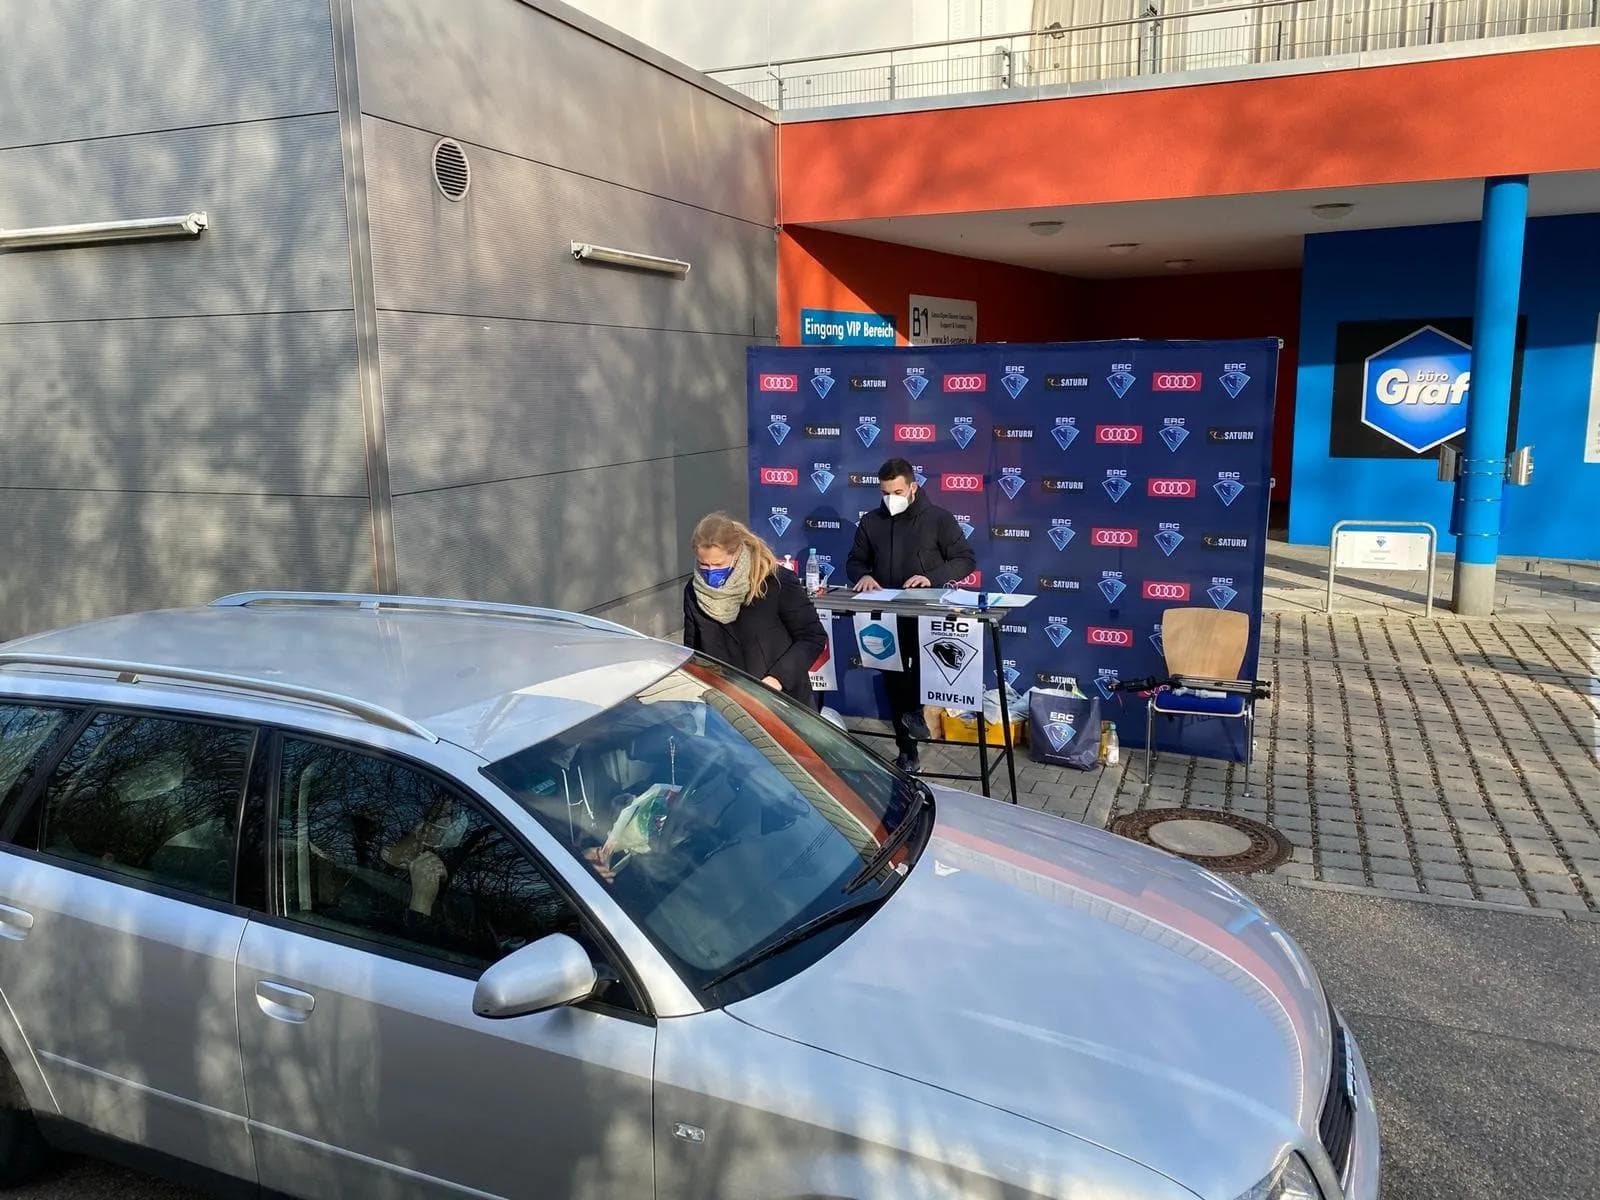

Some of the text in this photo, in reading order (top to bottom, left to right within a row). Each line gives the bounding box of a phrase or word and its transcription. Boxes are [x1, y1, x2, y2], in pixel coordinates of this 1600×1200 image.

[912, 306, 929, 337] B1
[804, 317, 894, 340] Eingang VIP Bereich
[813, 367, 832, 375] ERC
[906, 367, 926, 375] ERC
[1005, 365, 1025, 373] ERC
[1111, 363, 1132, 371] ERC
[1417, 370, 1449, 382] büro
[862, 379, 887, 388] SATURN
[1060, 377, 1089, 387] SATURN
[1376, 368, 1471, 405] Graf
[770, 414, 788, 422] ERC
[954, 416, 973, 424] ERC
[1163, 417, 1186, 425] ERC
[816, 427, 841, 436] SATURN
[1006, 429, 1033, 438] SATURN
[1224, 431, 1254, 441] SATURN
[1002, 467, 1022, 475] ERC
[1106, 469, 1128, 477] ERC
[1218, 471, 1240, 479] ERC
[861, 476, 881, 484] SATU
[1056, 480, 1084, 490] SATURN
[817, 520, 841, 529] SATURN
[1051, 518, 1072, 526] ERC
[1158, 522, 1180, 530] ERC
[1004, 529, 1030, 538] SATURN
[1218, 537, 1248, 548] SATURN
[1102, 570, 1123, 578] ERC
[1052, 580, 1080, 590] SATURN
[1211, 577, 1234, 585] ERC
[931, 621, 969, 633] ERC
[1001, 624, 1027, 634] SATURN
[1002, 659, 1016, 667] RC
[1098, 668, 1119, 676] ERC
[1049, 675, 1077, 684] SATURN
[927, 691, 975, 705] DRIVE-IN
[1050, 711, 1074, 722] ERC
